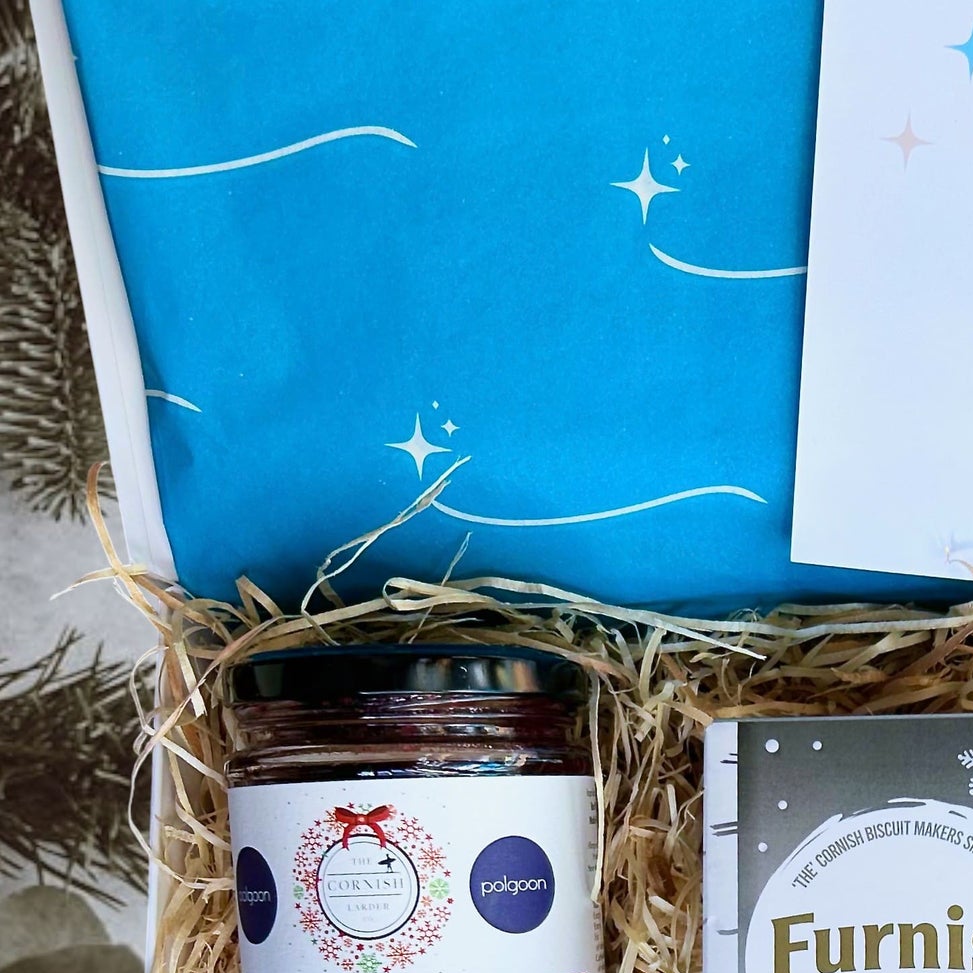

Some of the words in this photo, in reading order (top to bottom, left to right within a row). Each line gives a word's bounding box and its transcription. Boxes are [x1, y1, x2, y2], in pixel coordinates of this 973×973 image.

[815, 829, 865, 868] CORNISH
[864, 820, 911, 842] BISCUIT
[914, 820, 964, 845] MAKERS
[327, 879, 403, 891] CORNISH
[481, 875, 547, 897] polgoon
[347, 902, 390, 912] LARDER
